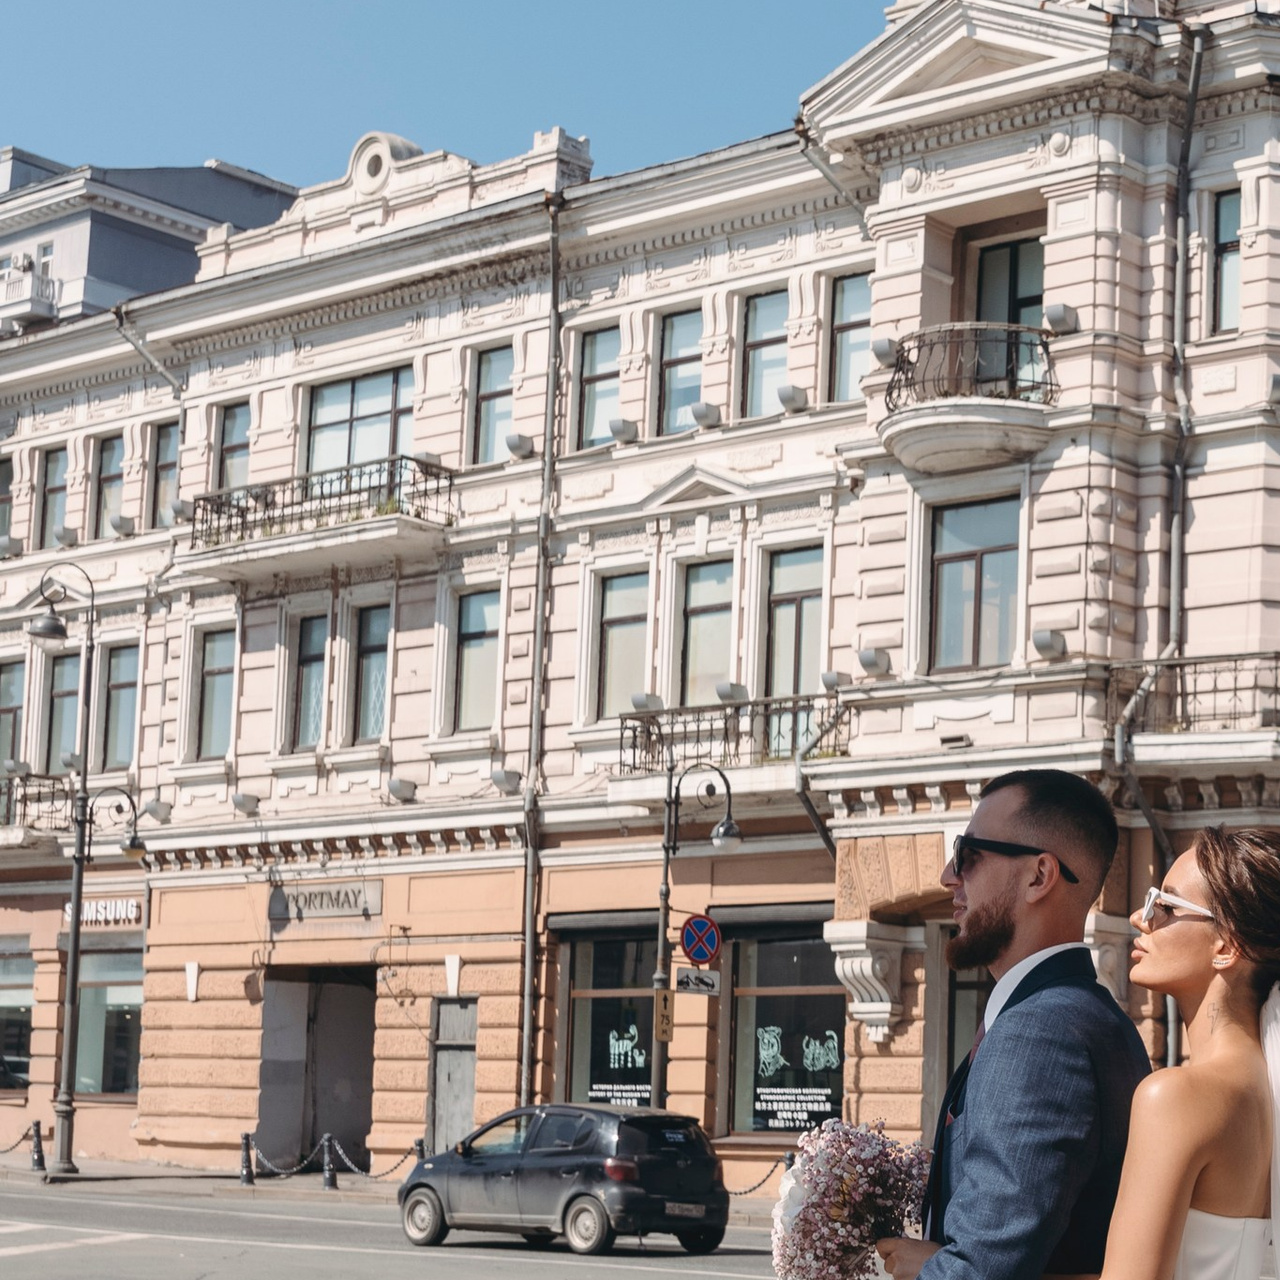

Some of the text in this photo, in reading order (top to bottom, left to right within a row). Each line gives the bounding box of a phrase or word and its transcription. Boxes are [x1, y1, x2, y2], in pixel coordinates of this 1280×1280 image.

[286, 889, 362, 910] PORTMAY
[65, 899, 137, 922] SMSUNG
[660, 1014, 670, 1026] 75
